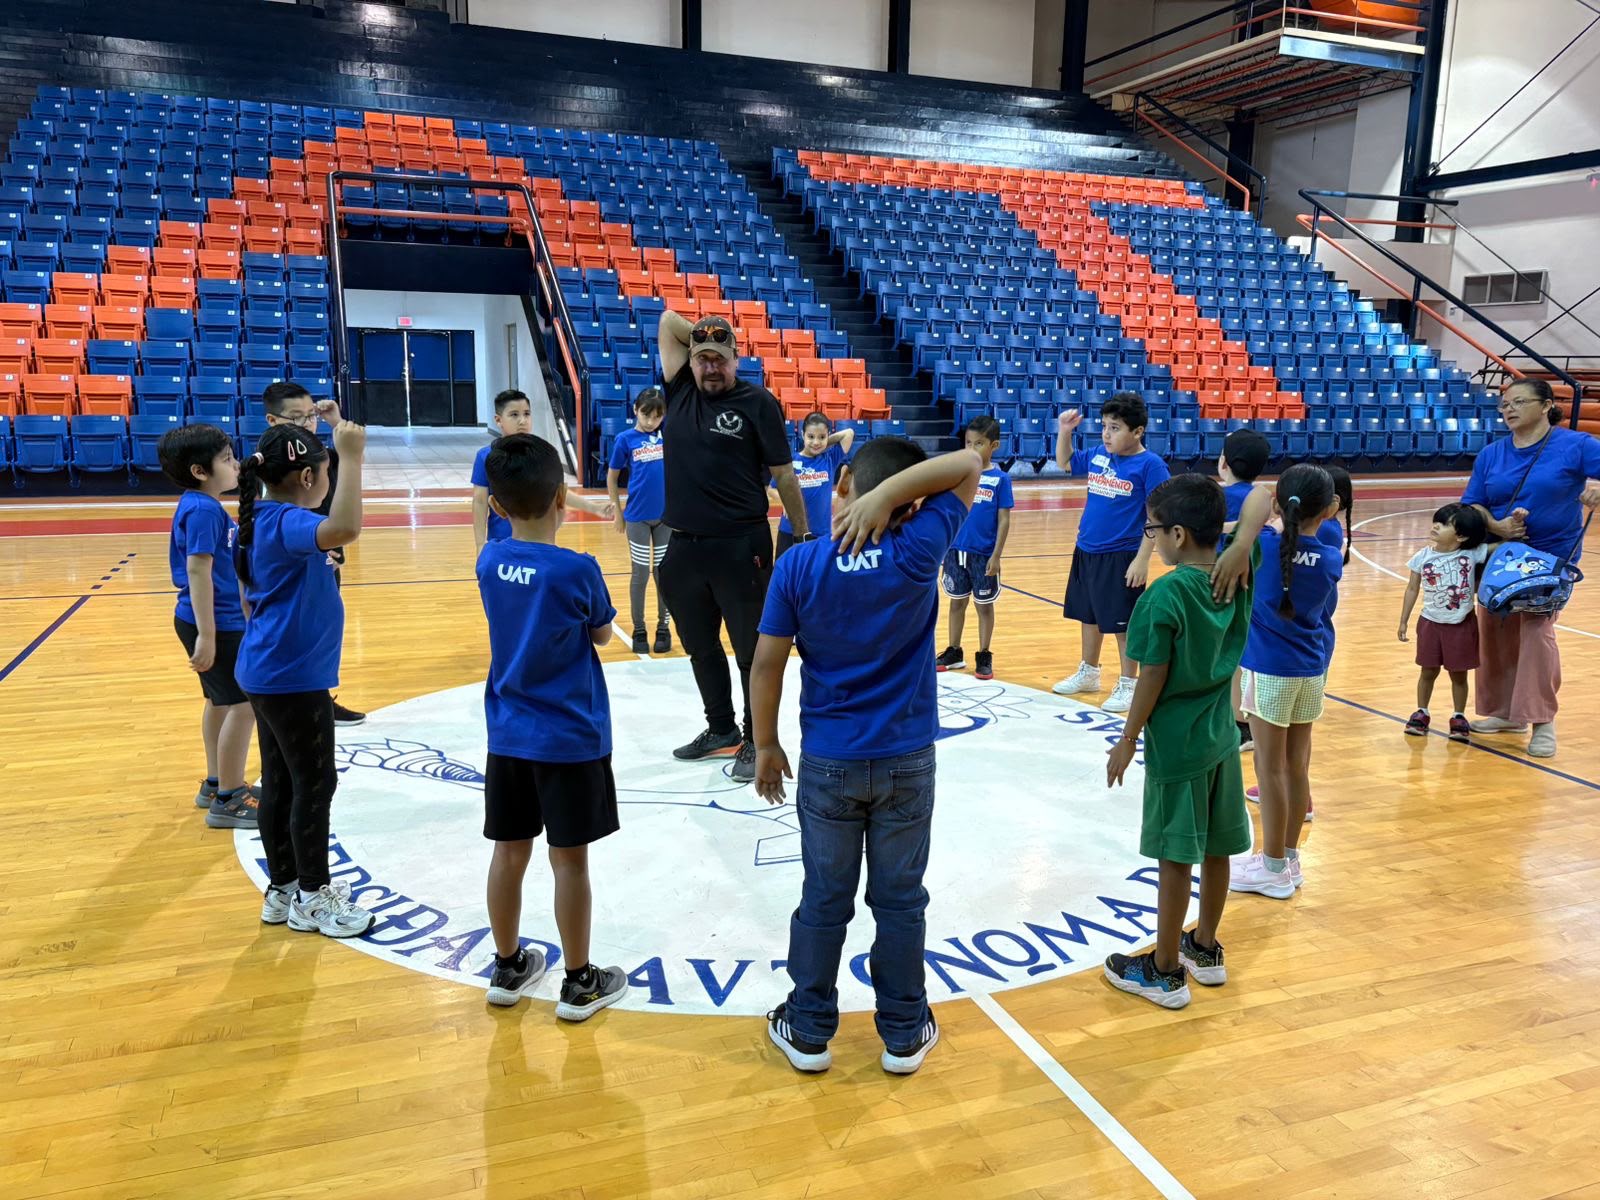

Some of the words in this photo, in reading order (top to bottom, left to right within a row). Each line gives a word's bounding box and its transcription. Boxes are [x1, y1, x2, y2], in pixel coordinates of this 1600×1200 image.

[1088, 473, 1132, 492] AMPAMENTO
[836, 549, 883, 573] UAT
[497, 563, 537, 585] UAT
